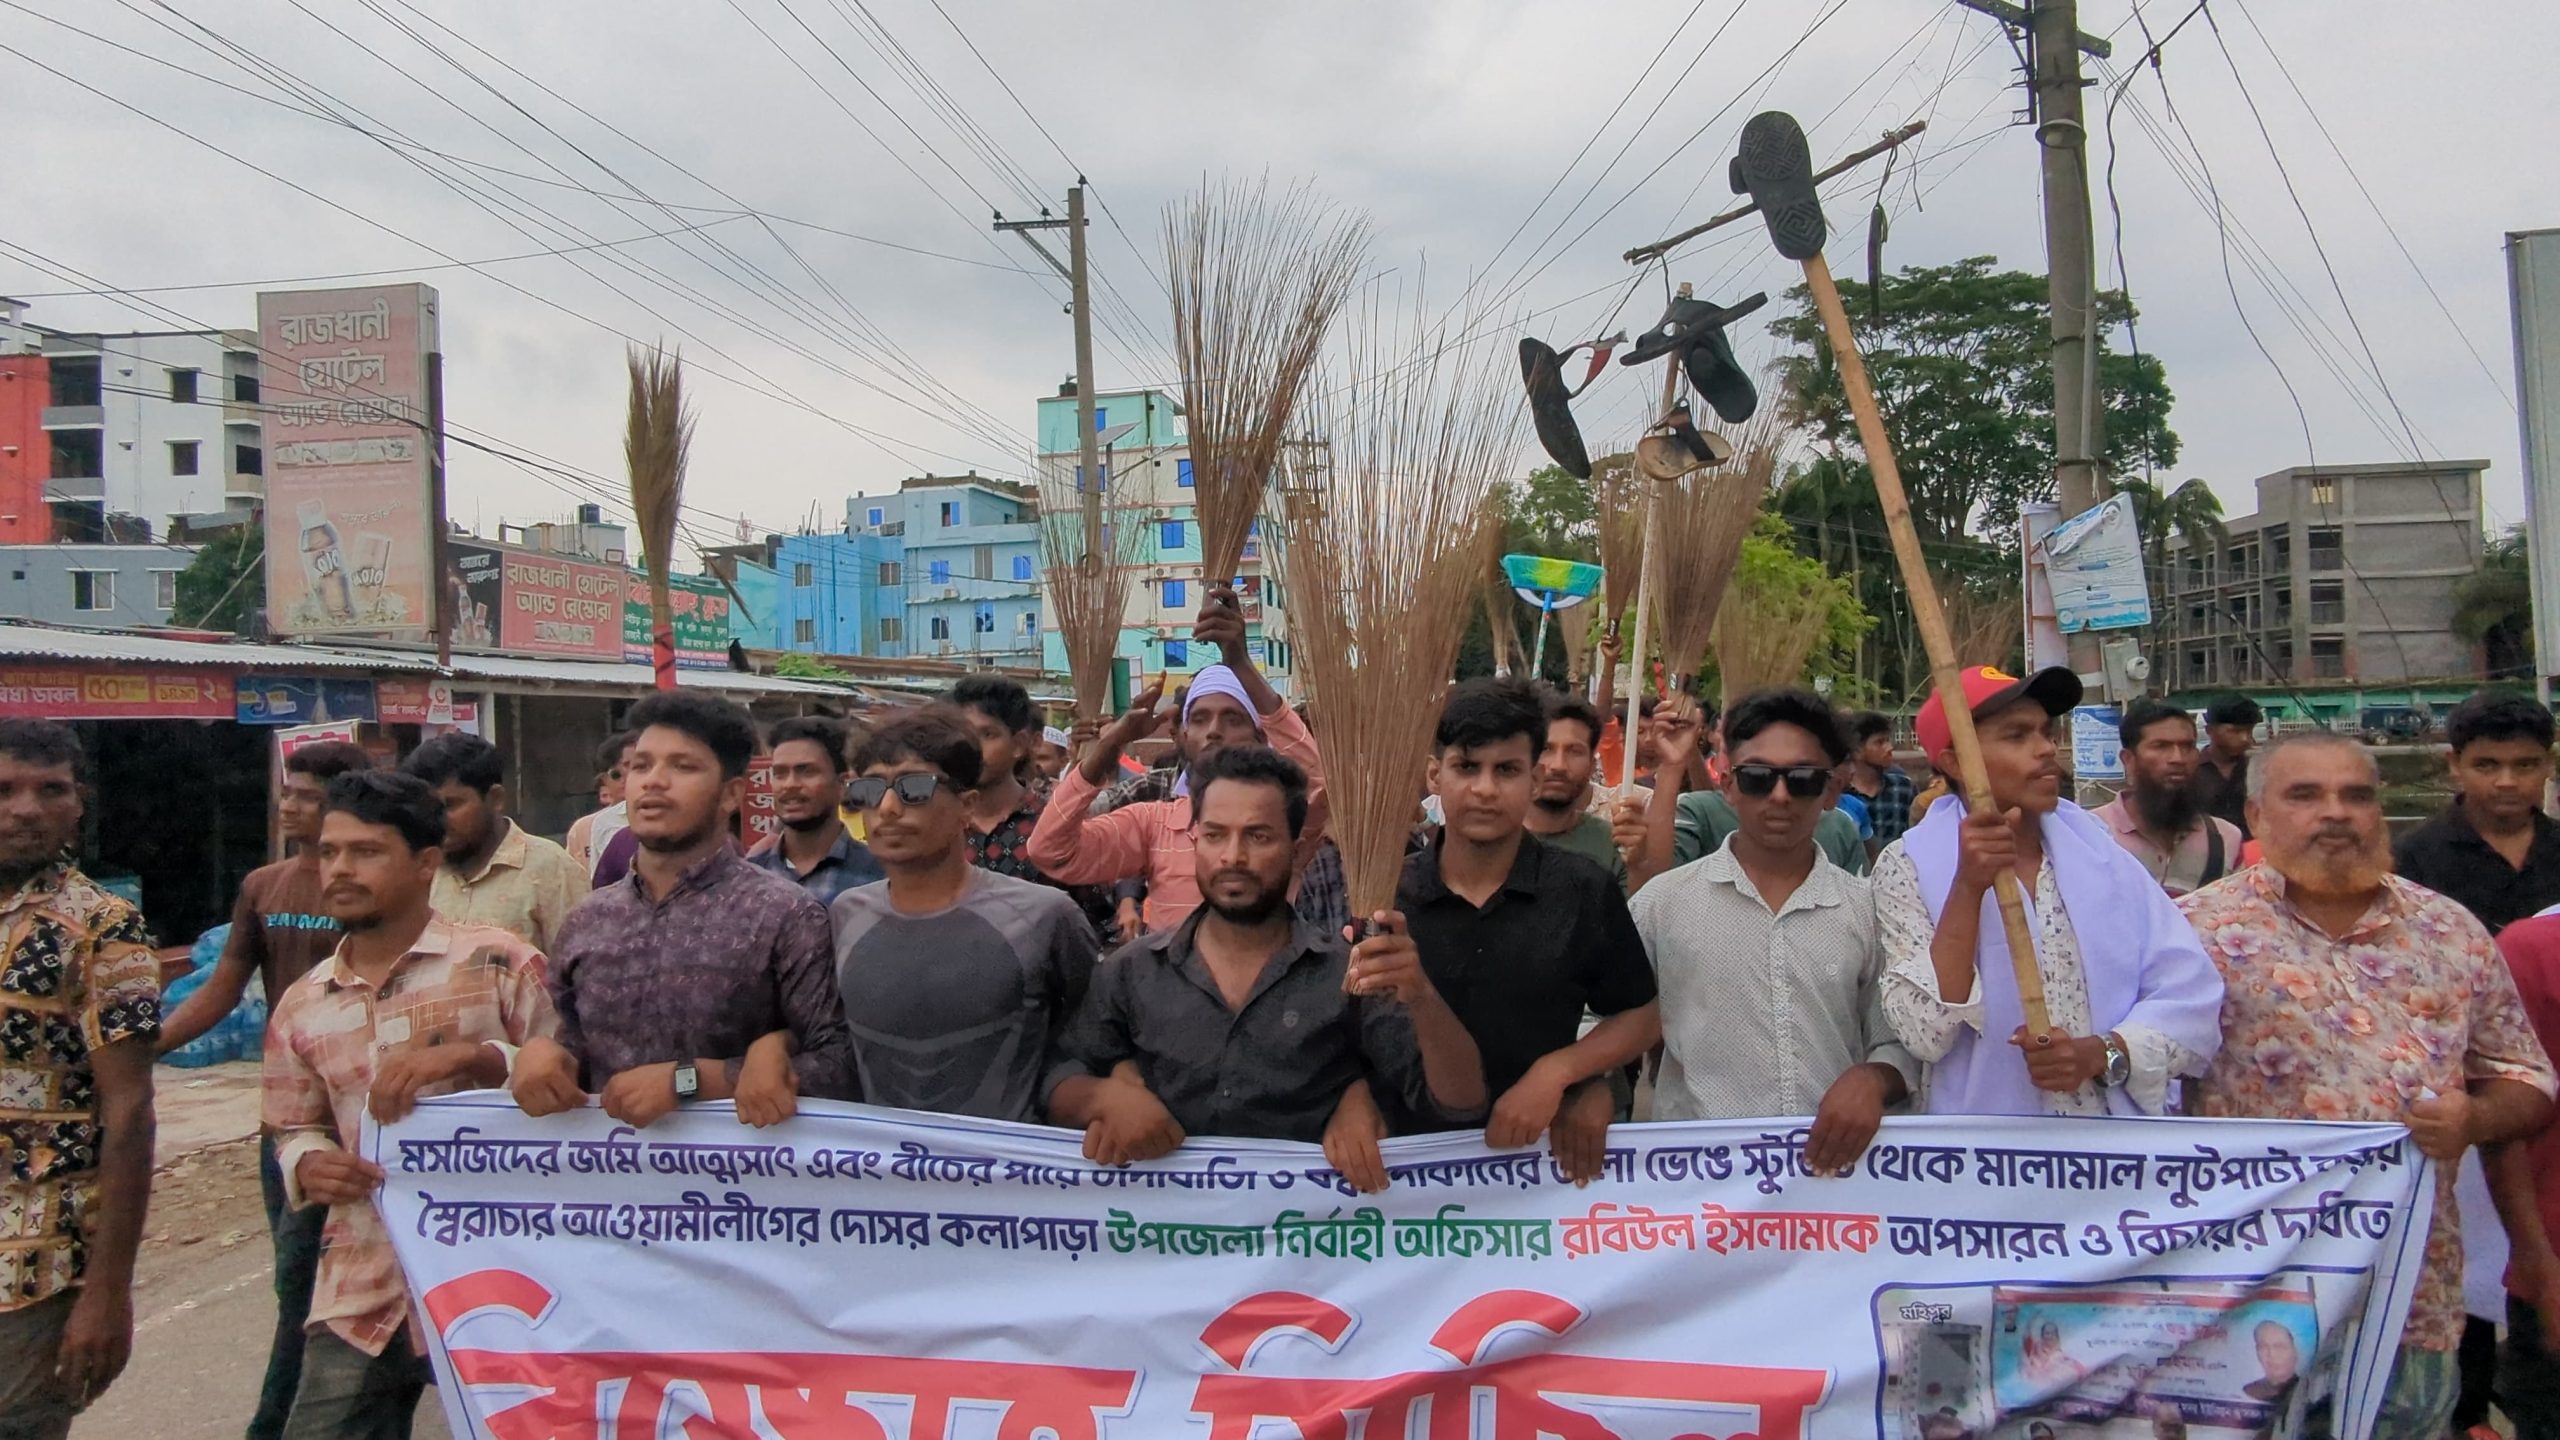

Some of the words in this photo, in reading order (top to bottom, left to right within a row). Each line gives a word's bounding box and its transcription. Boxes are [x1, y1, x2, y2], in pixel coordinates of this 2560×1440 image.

[278, 296, 392, 351] রাজধানী
[299, 347, 386, 394] হোটেল
[506, 562, 571, 591] রাজধানী
[576, 573, 621, 599] হোটেল
[399, 1126, 562, 1177] মসজিদের
[568, 1127, 641, 1174] জমি
[648, 1143, 797, 1185] আত্মসাৎ
[806, 1147, 882, 1180] এবং
[891, 1141, 997, 1186] বীচের
[1645, 1143, 1733, 1182] ভেঙে
[1866, 1144, 1967, 1183] থেকে
[1974, 1147, 2147, 1190] মালামাল
[417, 1190, 556, 1247] স্বৈরাচার
[562, 1190, 820, 1248] আওয়ামীলীগের
[830, 1207, 930, 1251] দোসর
[937, 1212, 1098, 1262] কলাপাড়া
[1105, 1206, 1265, 1258] উপজেলা
[1273, 1205, 1385, 1263] নির্বাহী
[1392, 1204, 1552, 1262] অফিসার
[1558, 1202, 1695, 1260] রবিউল
[1701, 1202, 1880, 1256] ইসলামকে
[1887, 1215, 2070, 1263] অপসারন
[2080, 1223, 2112, 1256] ও
[2271, 1190, 2395, 1242] দাবিতে
